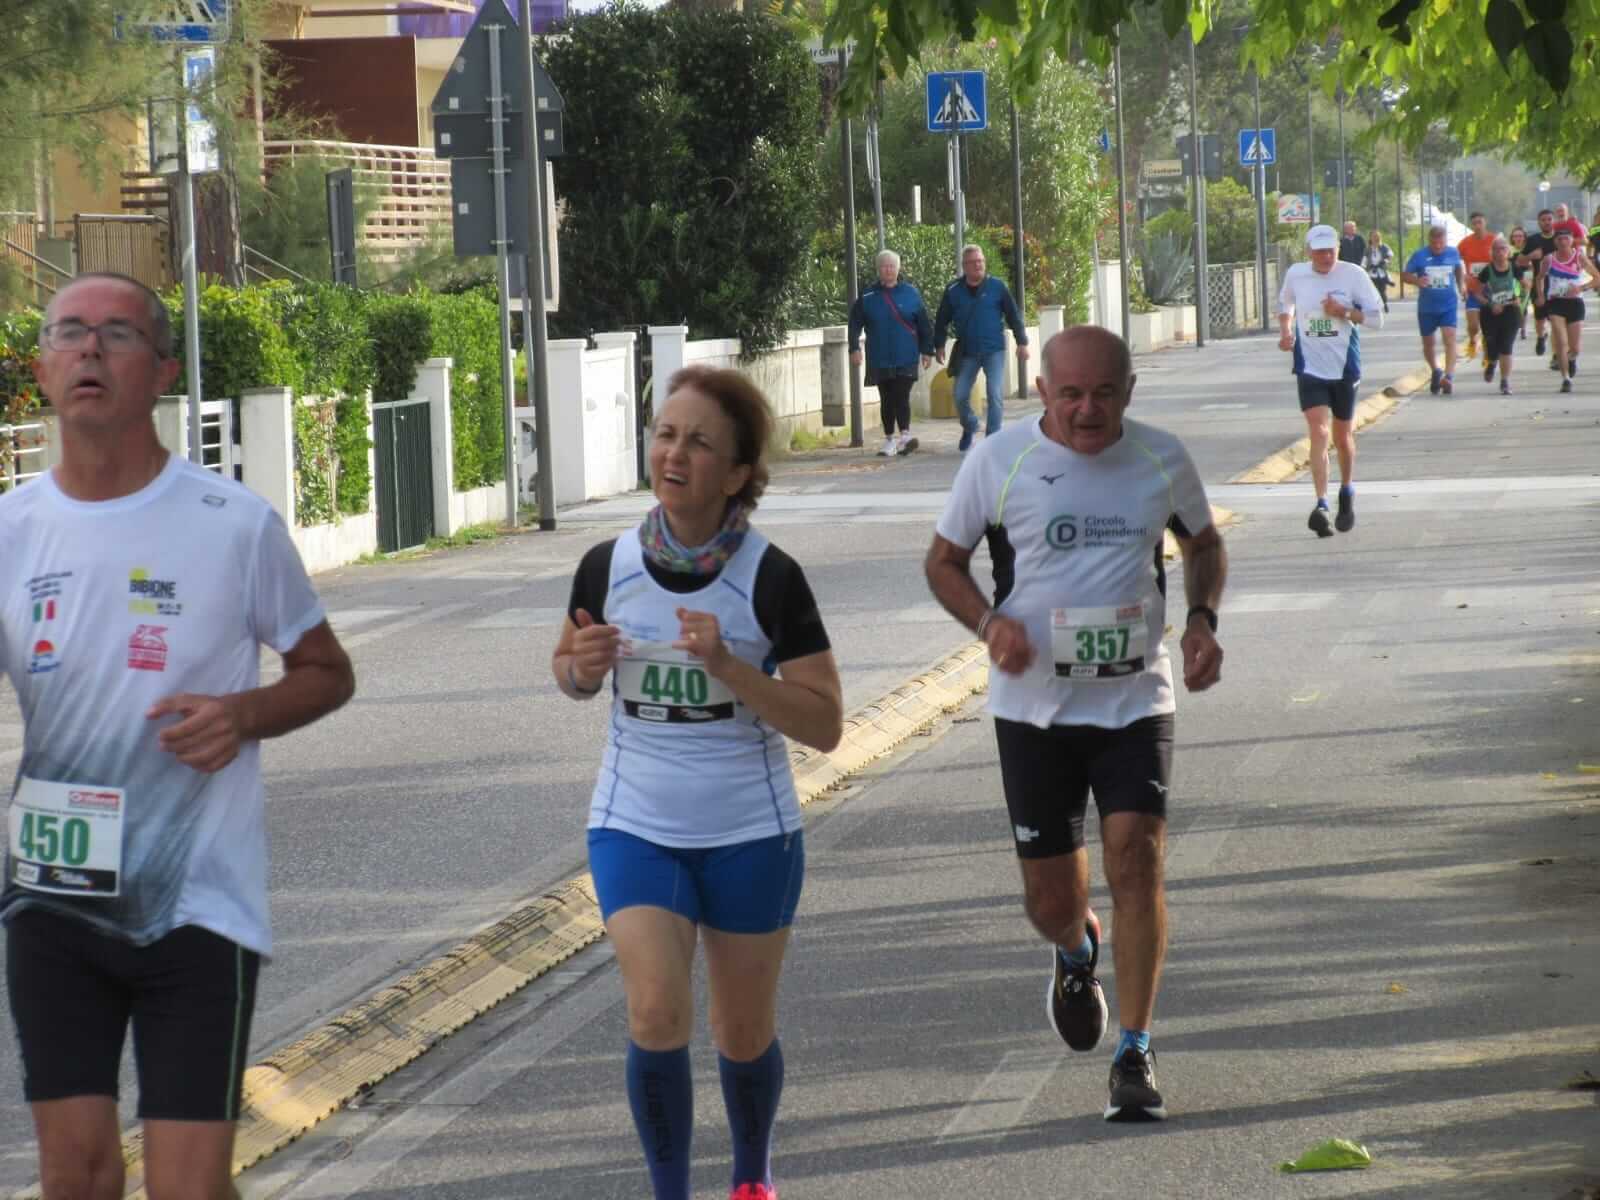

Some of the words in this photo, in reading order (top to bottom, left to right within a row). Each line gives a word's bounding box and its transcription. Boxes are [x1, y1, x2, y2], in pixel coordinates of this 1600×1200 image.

[1085, 515, 1126, 526] Circolo
[1085, 527, 1148, 539] Dipendenti
[1076, 628, 1130, 662] 357
[641, 664, 708, 705] 440
[19, 812, 90, 866] 450
